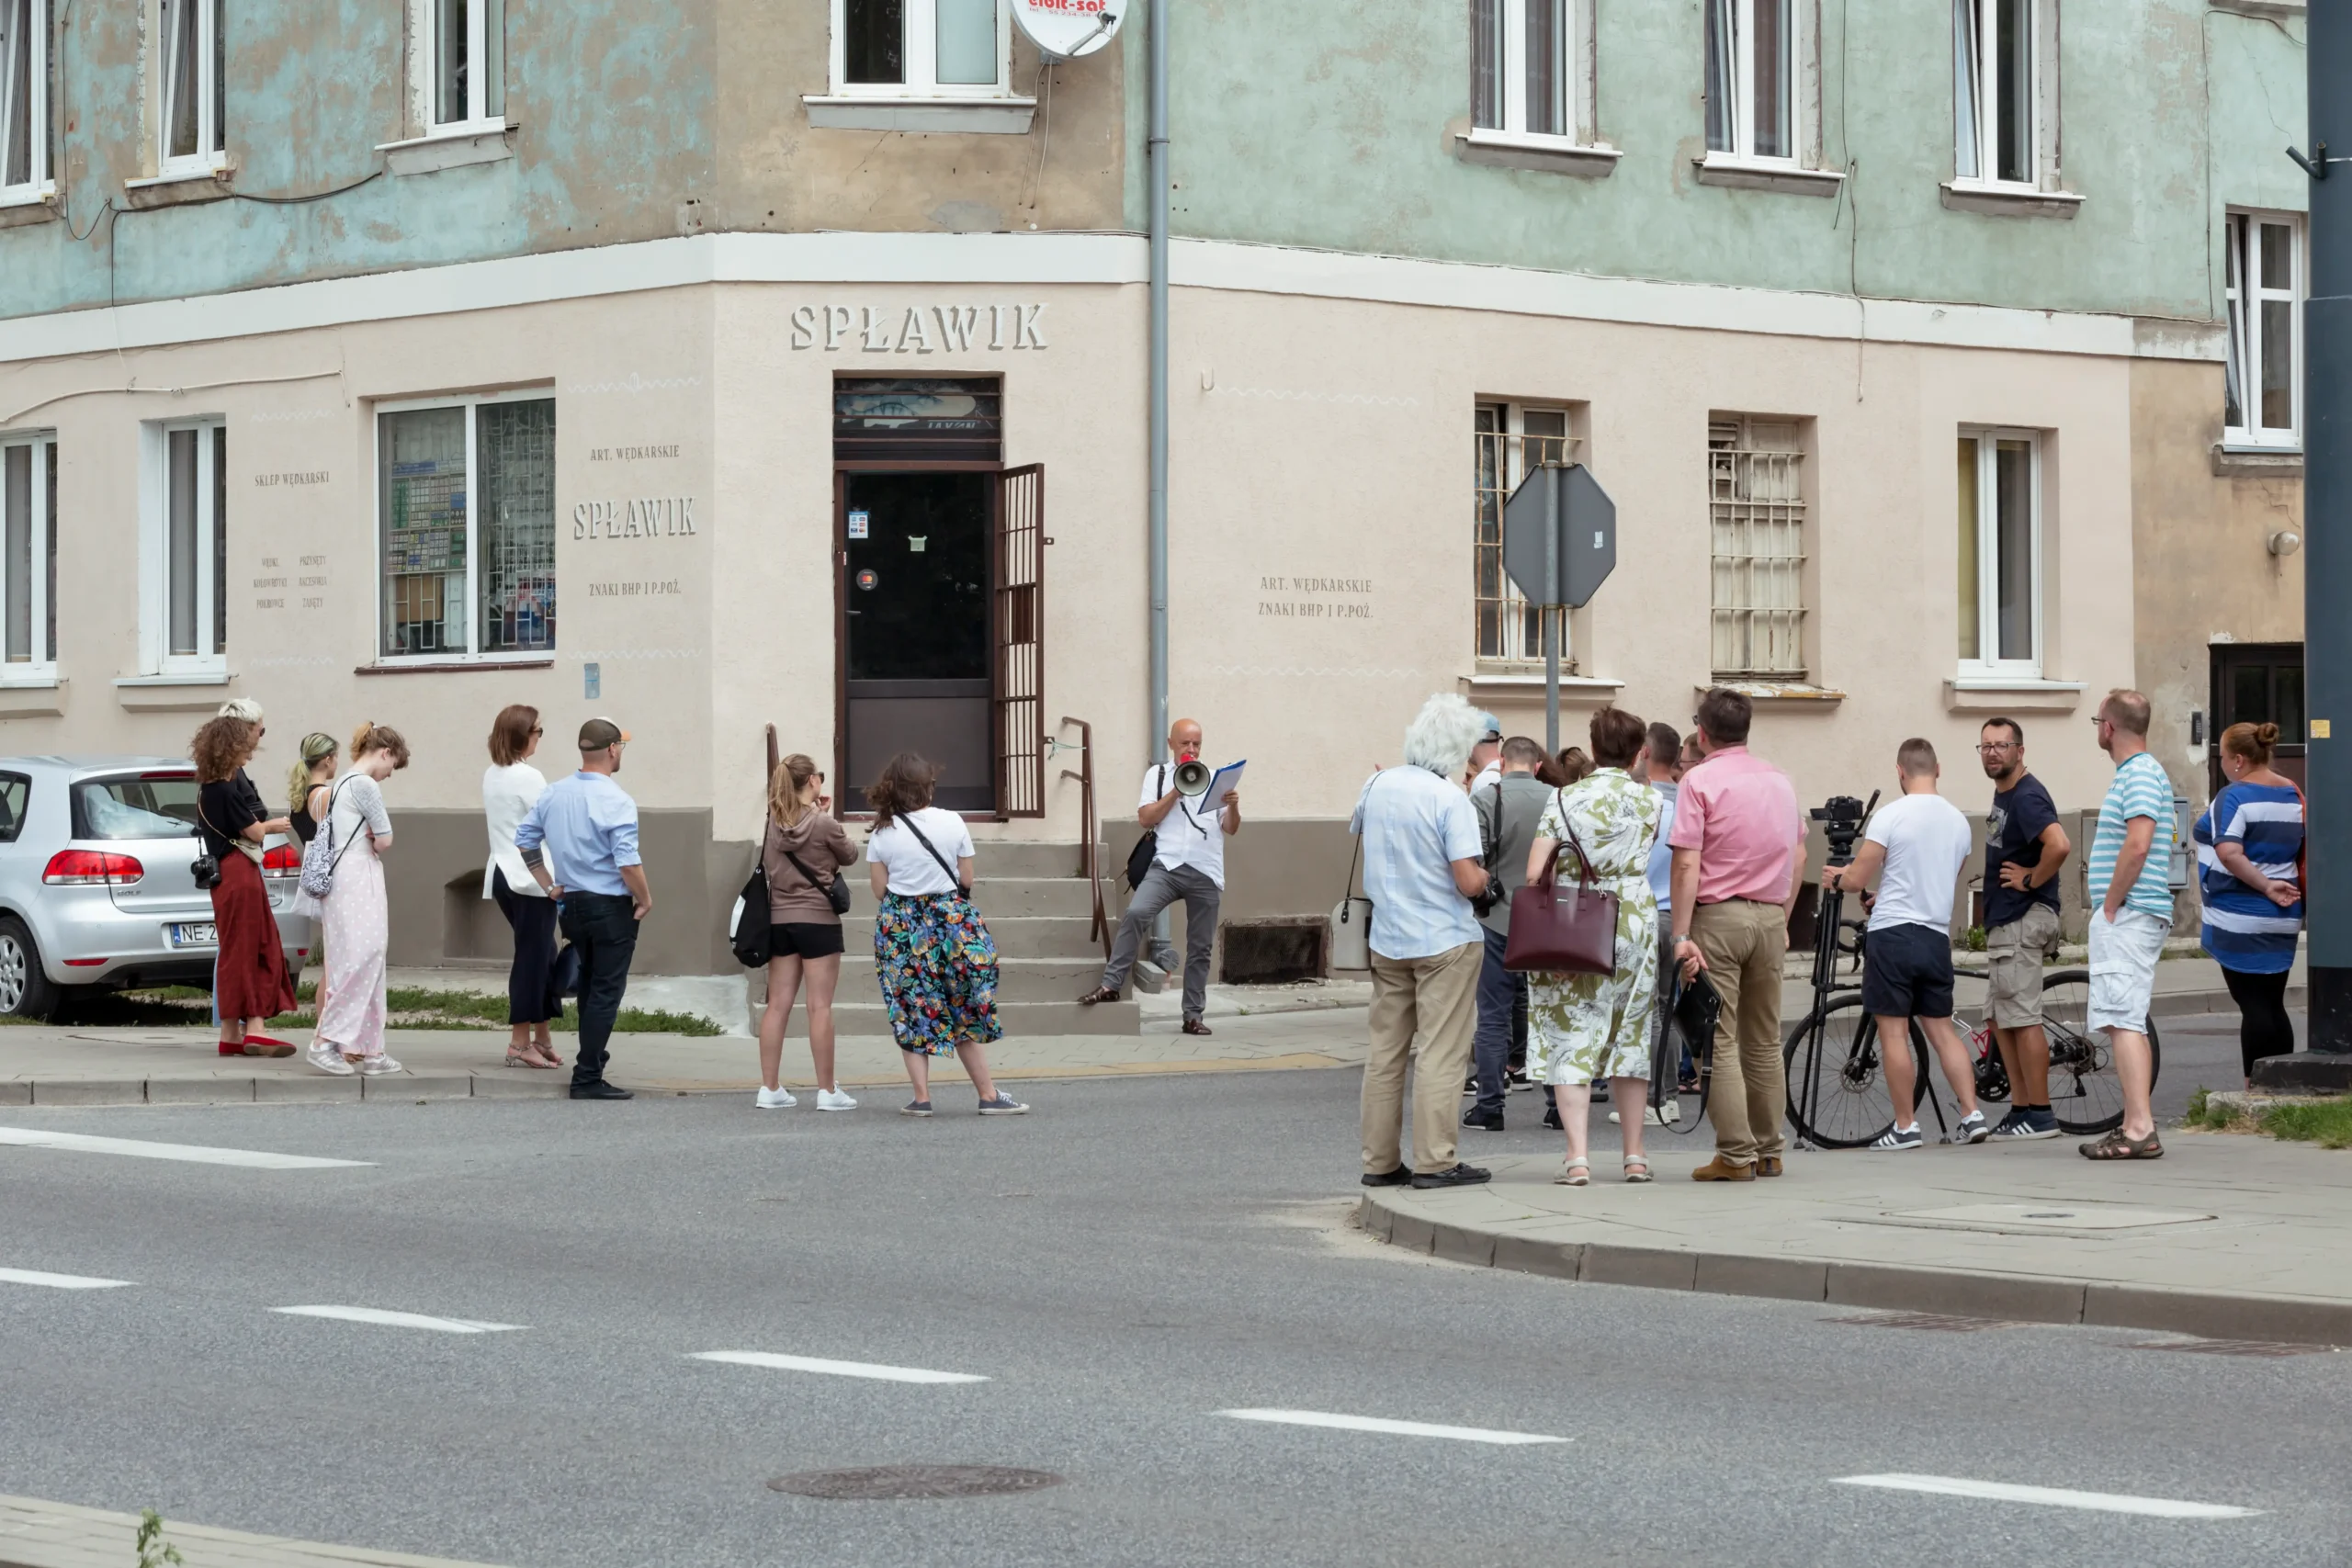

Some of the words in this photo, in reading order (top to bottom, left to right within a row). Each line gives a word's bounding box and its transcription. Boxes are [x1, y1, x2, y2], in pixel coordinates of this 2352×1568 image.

[791, 303, 1049, 354] SPŁAWIK
[590, 448, 613, 461] ART.
[616, 445, 680, 462] WĘDKARSKIE
[254, 474, 279, 487] SKLEP
[282, 471, 329, 488] WĘDKARSKI
[573, 496, 696, 540] SPŁAWIK
[589, 583, 618, 596] ZNAKI
[622, 582, 641, 595] BHP
[644, 582, 649, 594] I
[651, 579, 682, 595] P.POŻ.
[1261, 577, 1288, 591] ART.
[1293, 578, 1372, 594] WĘDKARSKIE
[1258, 603, 1295, 616] ZNAKI
[1299, 604, 1323, 617] BHP
[1328, 604, 1332, 617] I
[1338, 603, 1374, 618] P.POŻ.
[182, 925, 204, 942] NE
